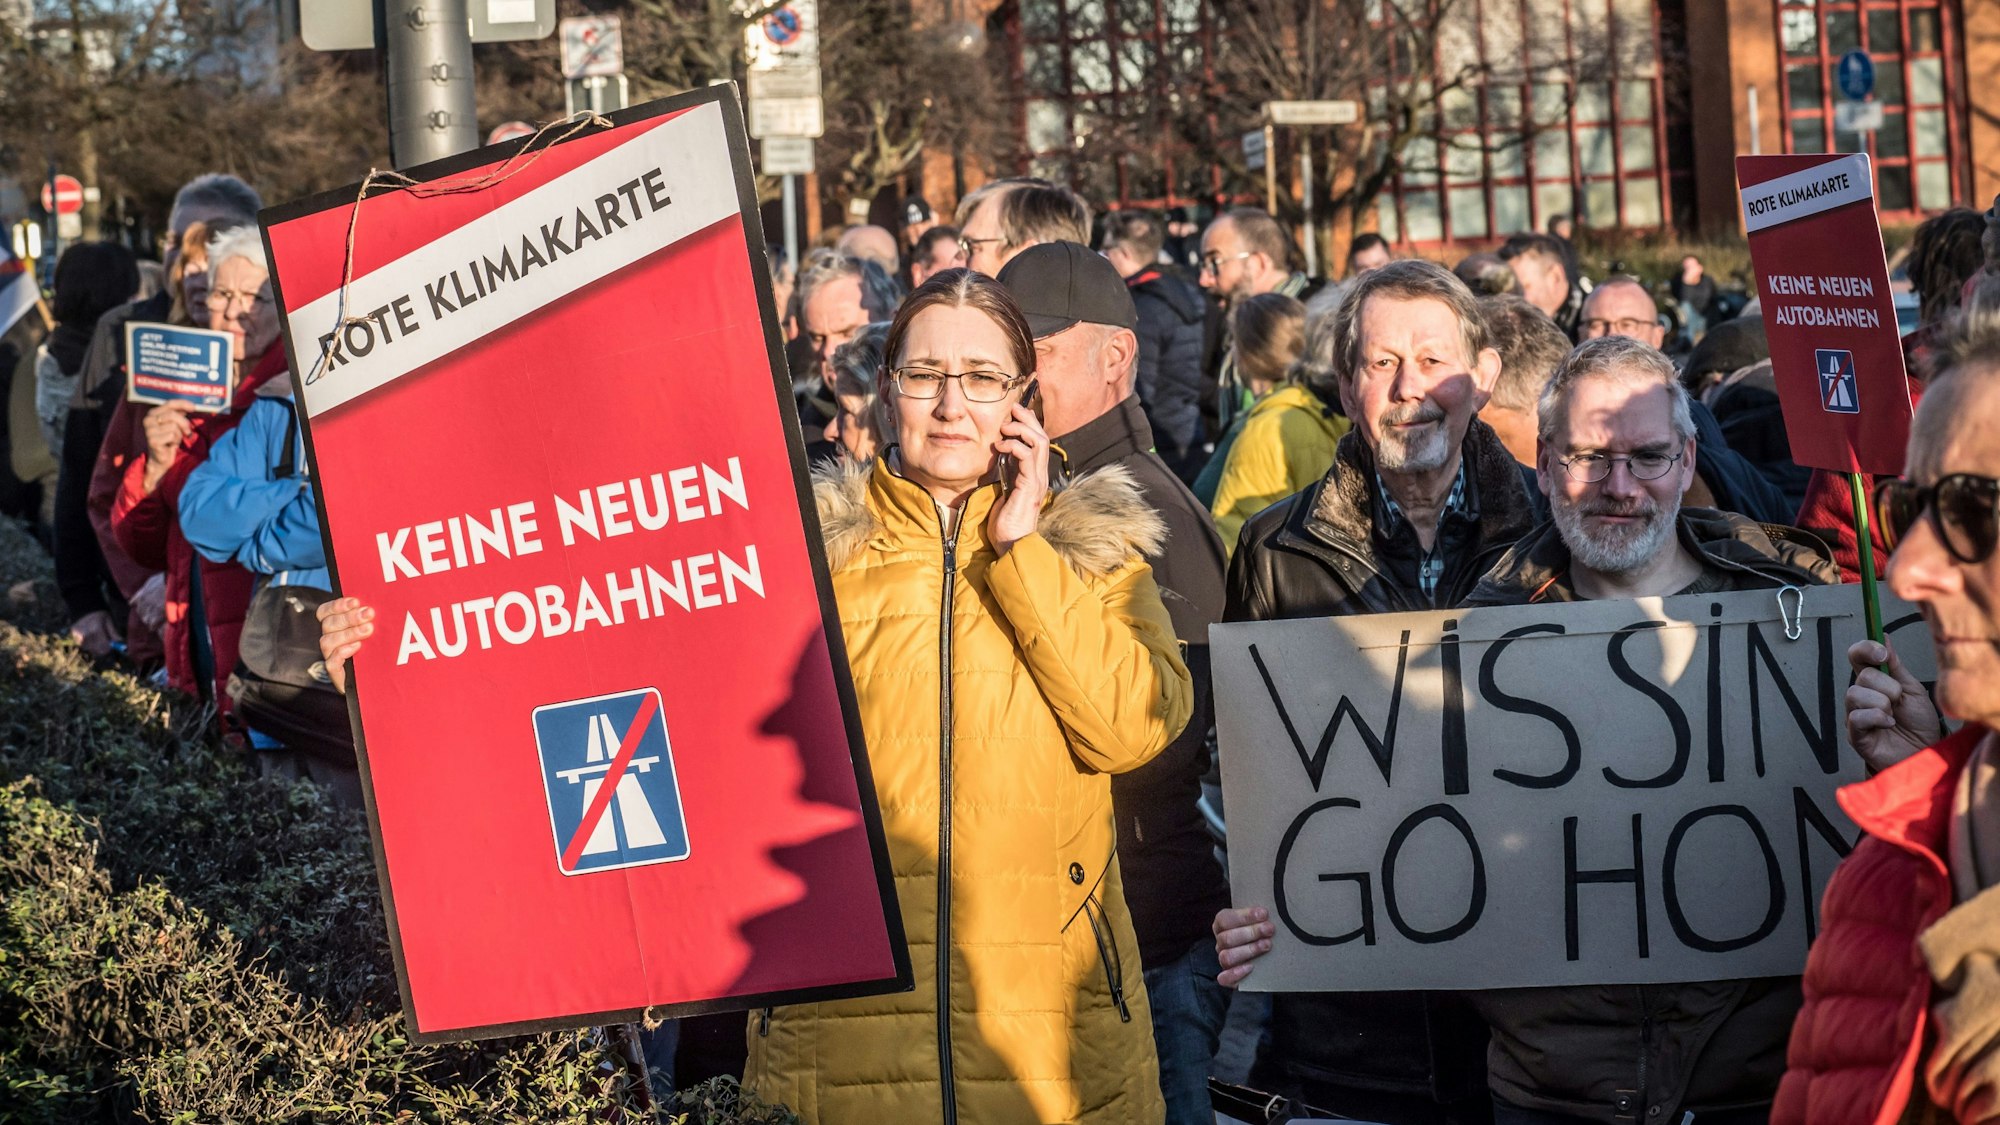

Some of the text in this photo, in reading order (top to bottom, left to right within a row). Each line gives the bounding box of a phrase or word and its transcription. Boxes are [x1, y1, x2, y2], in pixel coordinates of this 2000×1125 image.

[1747, 173, 1850, 217] ROTE KLIMAKARTE
[318, 167, 672, 371] ROTE KLIMAKARTE
[1767, 275, 1875, 298] KEINE NEUEN
[1776, 305, 1880, 329] AUTOBAHNEN
[375, 456, 749, 583] KEINE NEUEN
[396, 544, 766, 666] AUTOBAHNEN
[1273, 786, 1868, 962] GO HO
